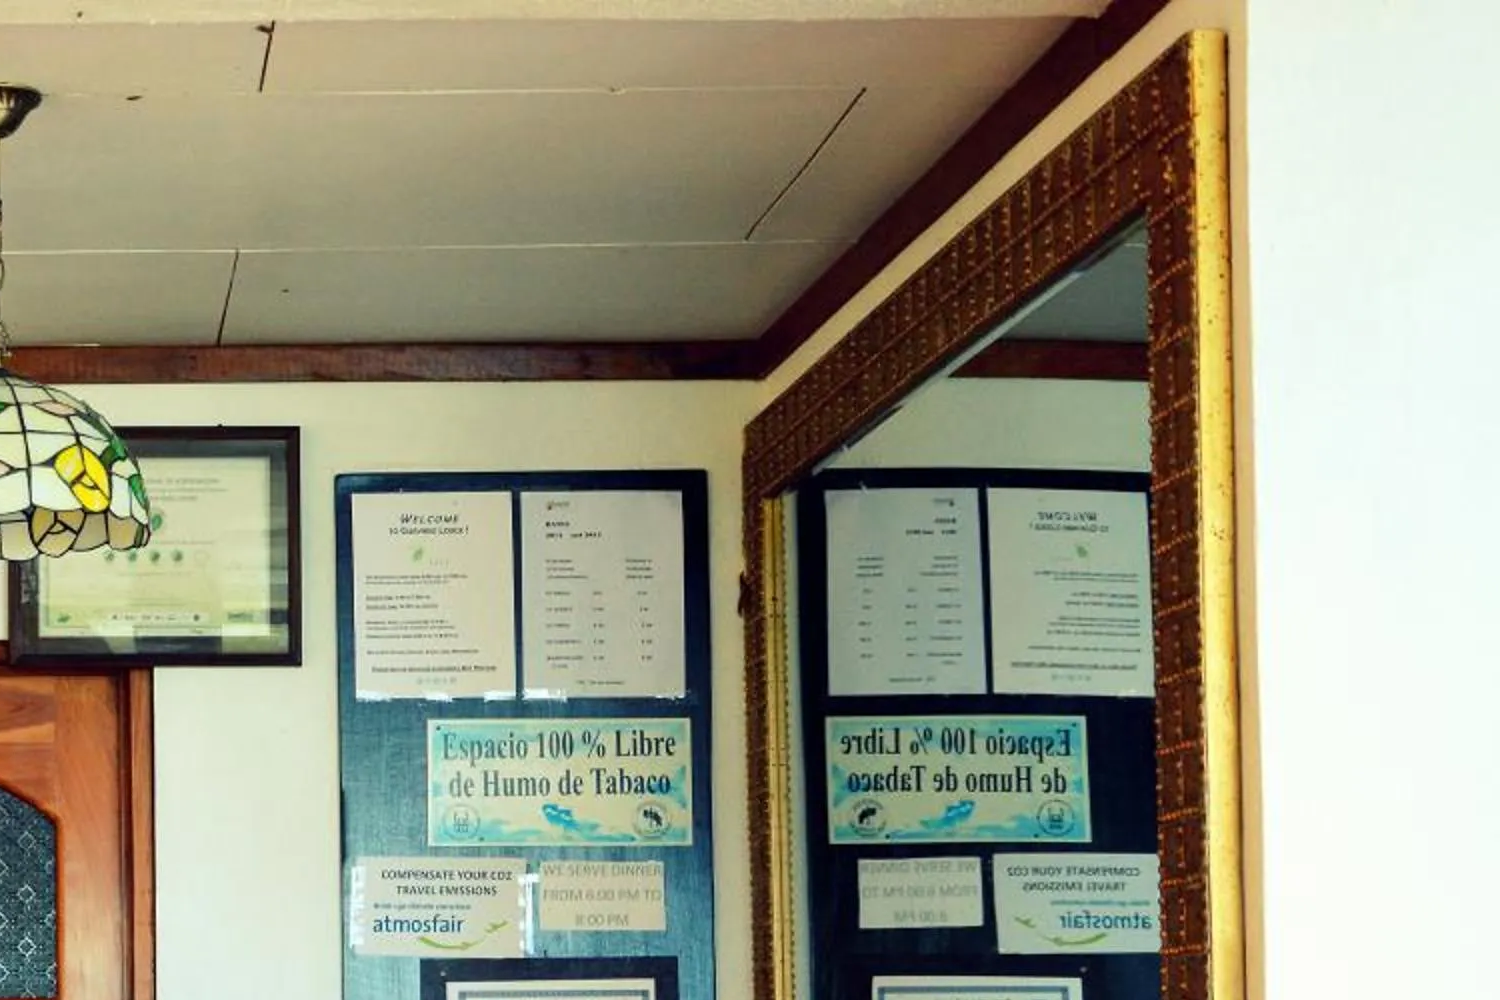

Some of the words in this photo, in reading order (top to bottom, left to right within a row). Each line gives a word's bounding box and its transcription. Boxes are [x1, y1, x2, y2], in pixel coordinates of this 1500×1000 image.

[443, 732, 528, 767] Espacio
[538, 730, 574, 758] 100
[582, 730, 606, 758] %
[615, 729, 676, 757] Libre
[450, 771, 475, 798] de
[482, 769, 550, 797] Humo
[558, 768, 583, 796] de
[589, 767, 671, 796] Tabaco
[381, 869, 455, 881] COMPENSATE
[457, 869, 489, 881] YOUR
[611, 864, 661, 876] DINNER
[397, 885, 437, 896] TRAVEL
[439, 885, 498, 896] EMISSIONS
[372, 914, 466, 934] atmosfair
